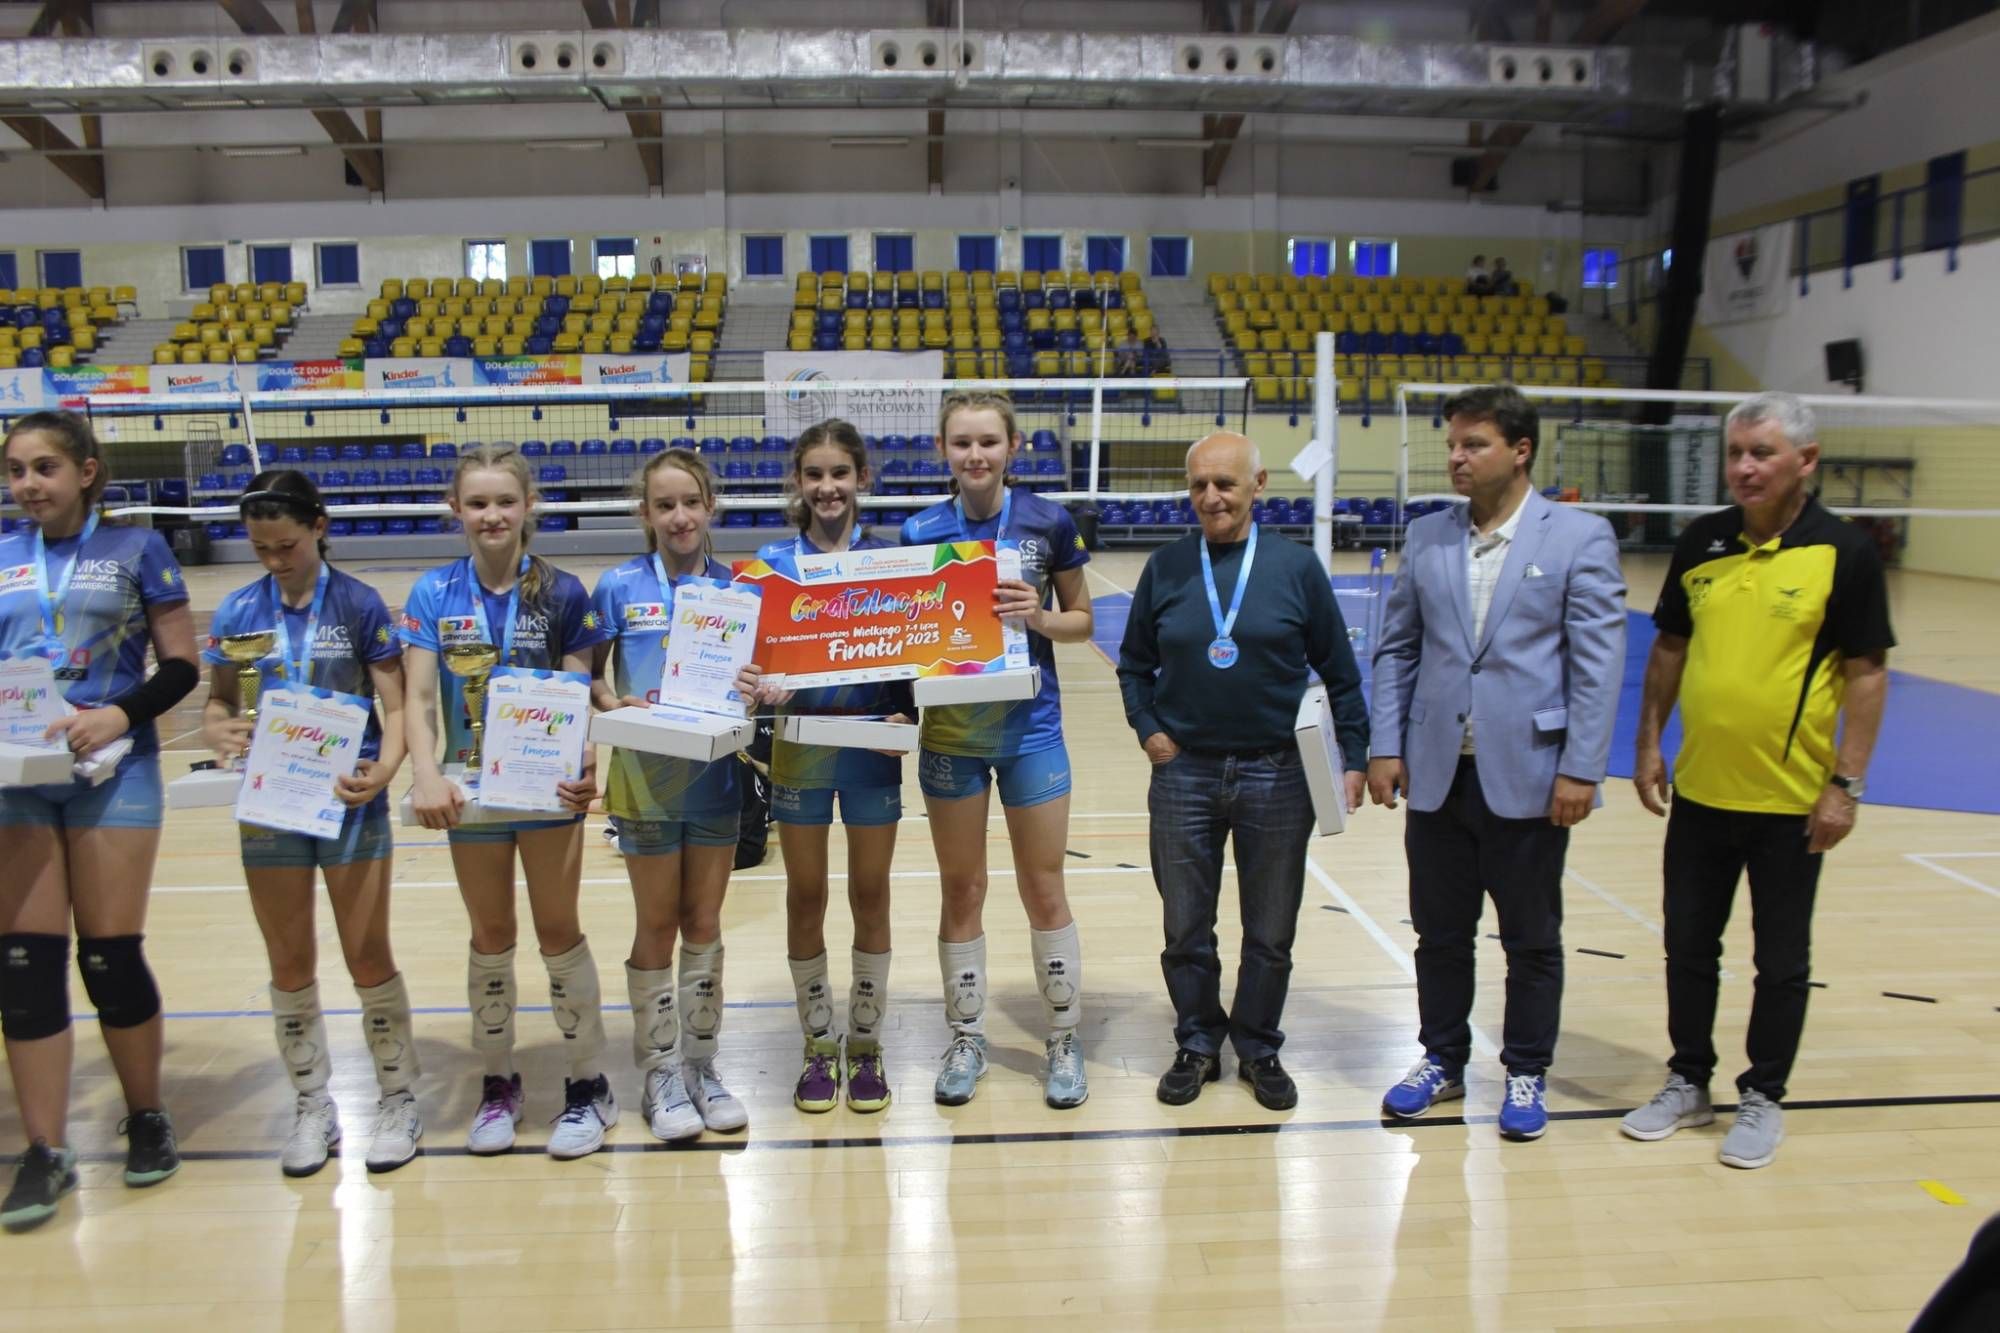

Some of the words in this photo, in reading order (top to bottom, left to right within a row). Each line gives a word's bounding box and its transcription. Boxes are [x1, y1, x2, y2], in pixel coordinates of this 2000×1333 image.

[790, 580, 947, 622] Gratulacje!
[853, 625, 901, 638] Wielkiego
[906, 631, 941, 646] 2023
[828, 636, 904, 662] Finału
